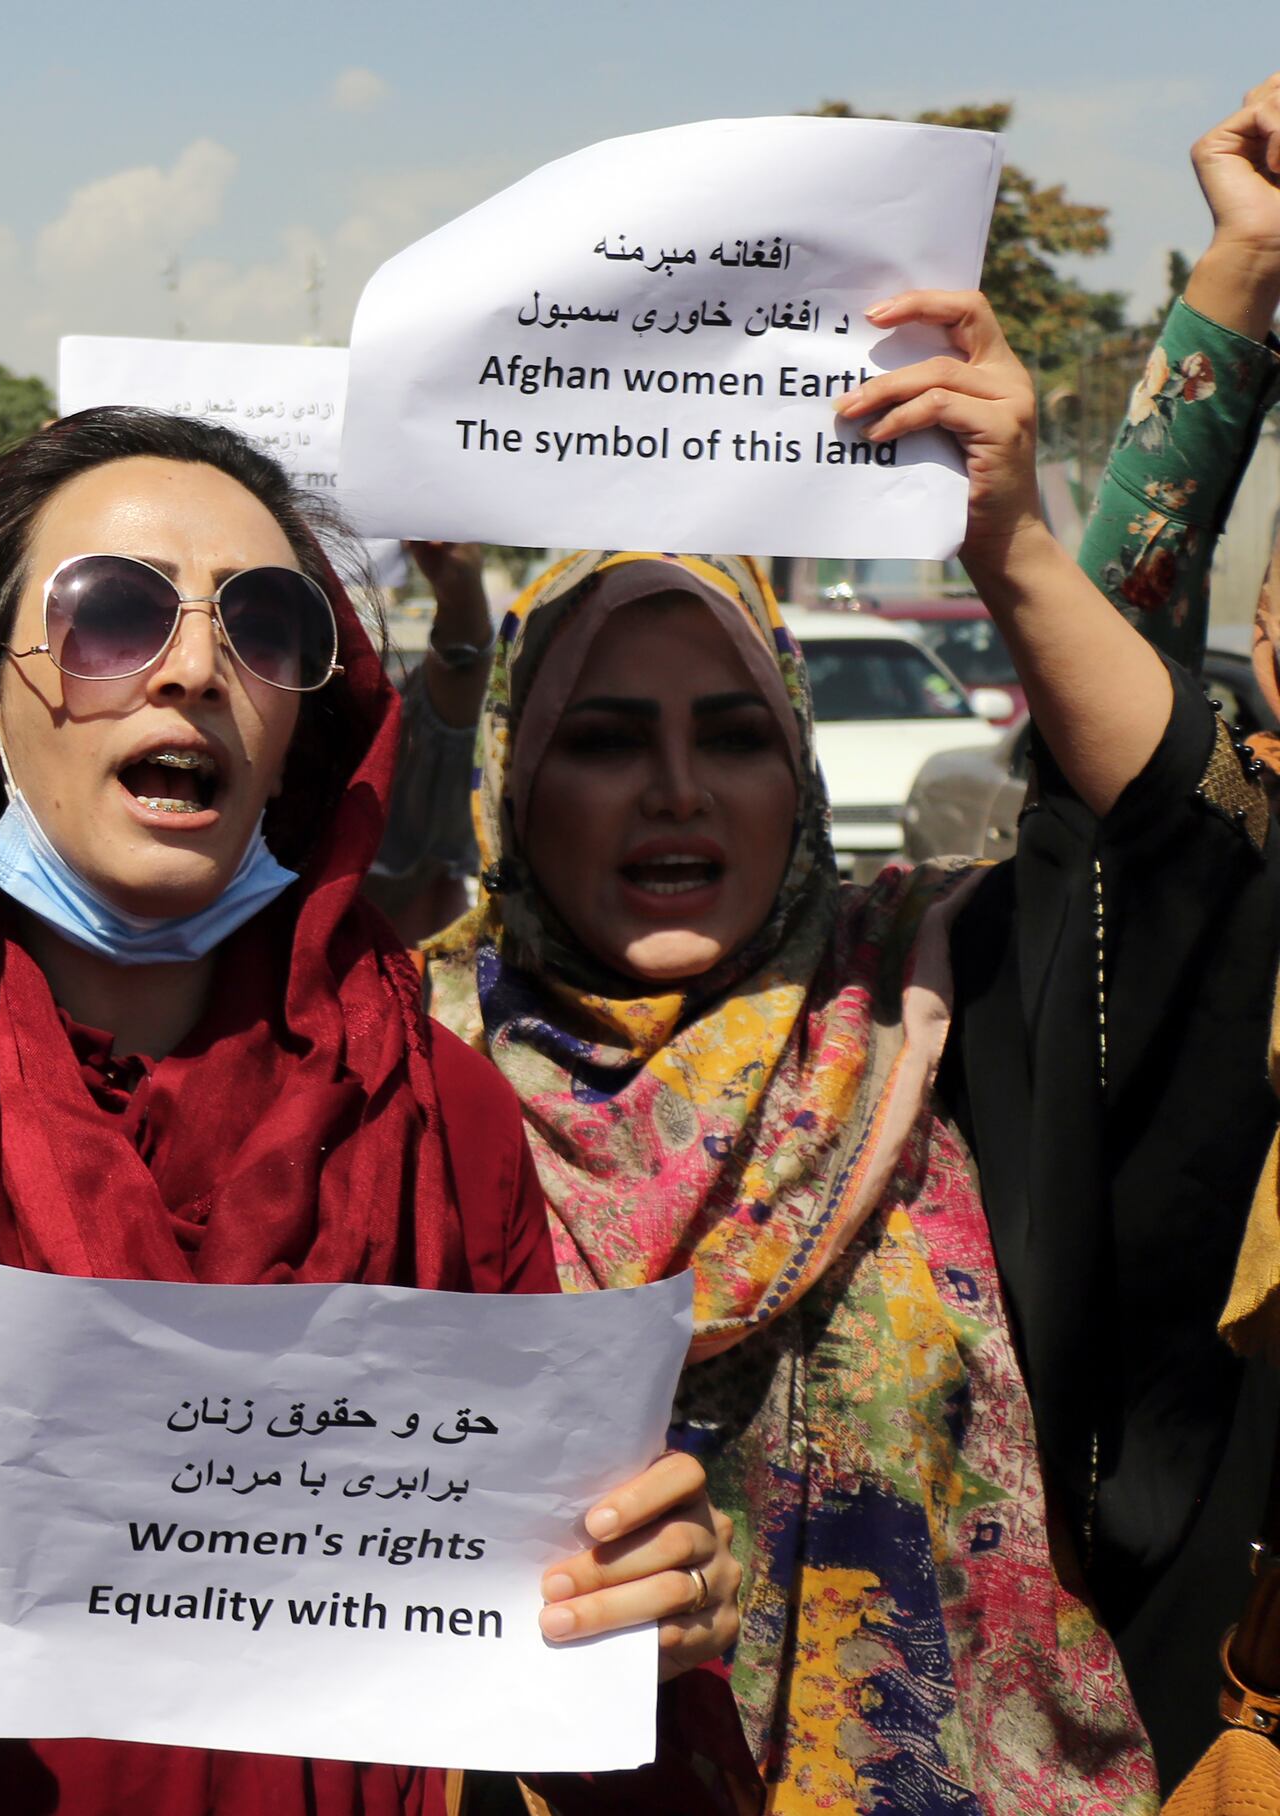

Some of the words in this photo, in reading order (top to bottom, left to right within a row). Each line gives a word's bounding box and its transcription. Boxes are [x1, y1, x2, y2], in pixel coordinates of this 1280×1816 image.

[708, 236, 792, 271] افغانه
[517, 290, 620, 329] سمبول
[744, 299, 820, 337] افغان
[834, 313, 850, 335] د
[478, 354, 611, 395] Afghan
[623, 368, 764, 397] women
[455, 418, 523, 453] The
[535, 424, 669, 462] symbol
[682, 428, 722, 461] of
[731, 429, 802, 464] this
[815, 431, 898, 466] land
[166, 1396, 255, 1435] زنان
[266, 1396, 378, 1439] حقوق
[390, 1412, 420, 1440] و
[432, 1406, 500, 1445] حق
[170, 1458, 282, 1495] مردان
[299, 1459, 328, 1497] با
[342, 1466, 470, 1503] برابری
[128, 1521, 344, 1557] Women's
[357, 1526, 486, 1566] rights
[88, 1584, 275, 1632] Equality
[287, 1591, 387, 1630] with
[404, 1604, 503, 1639] men
